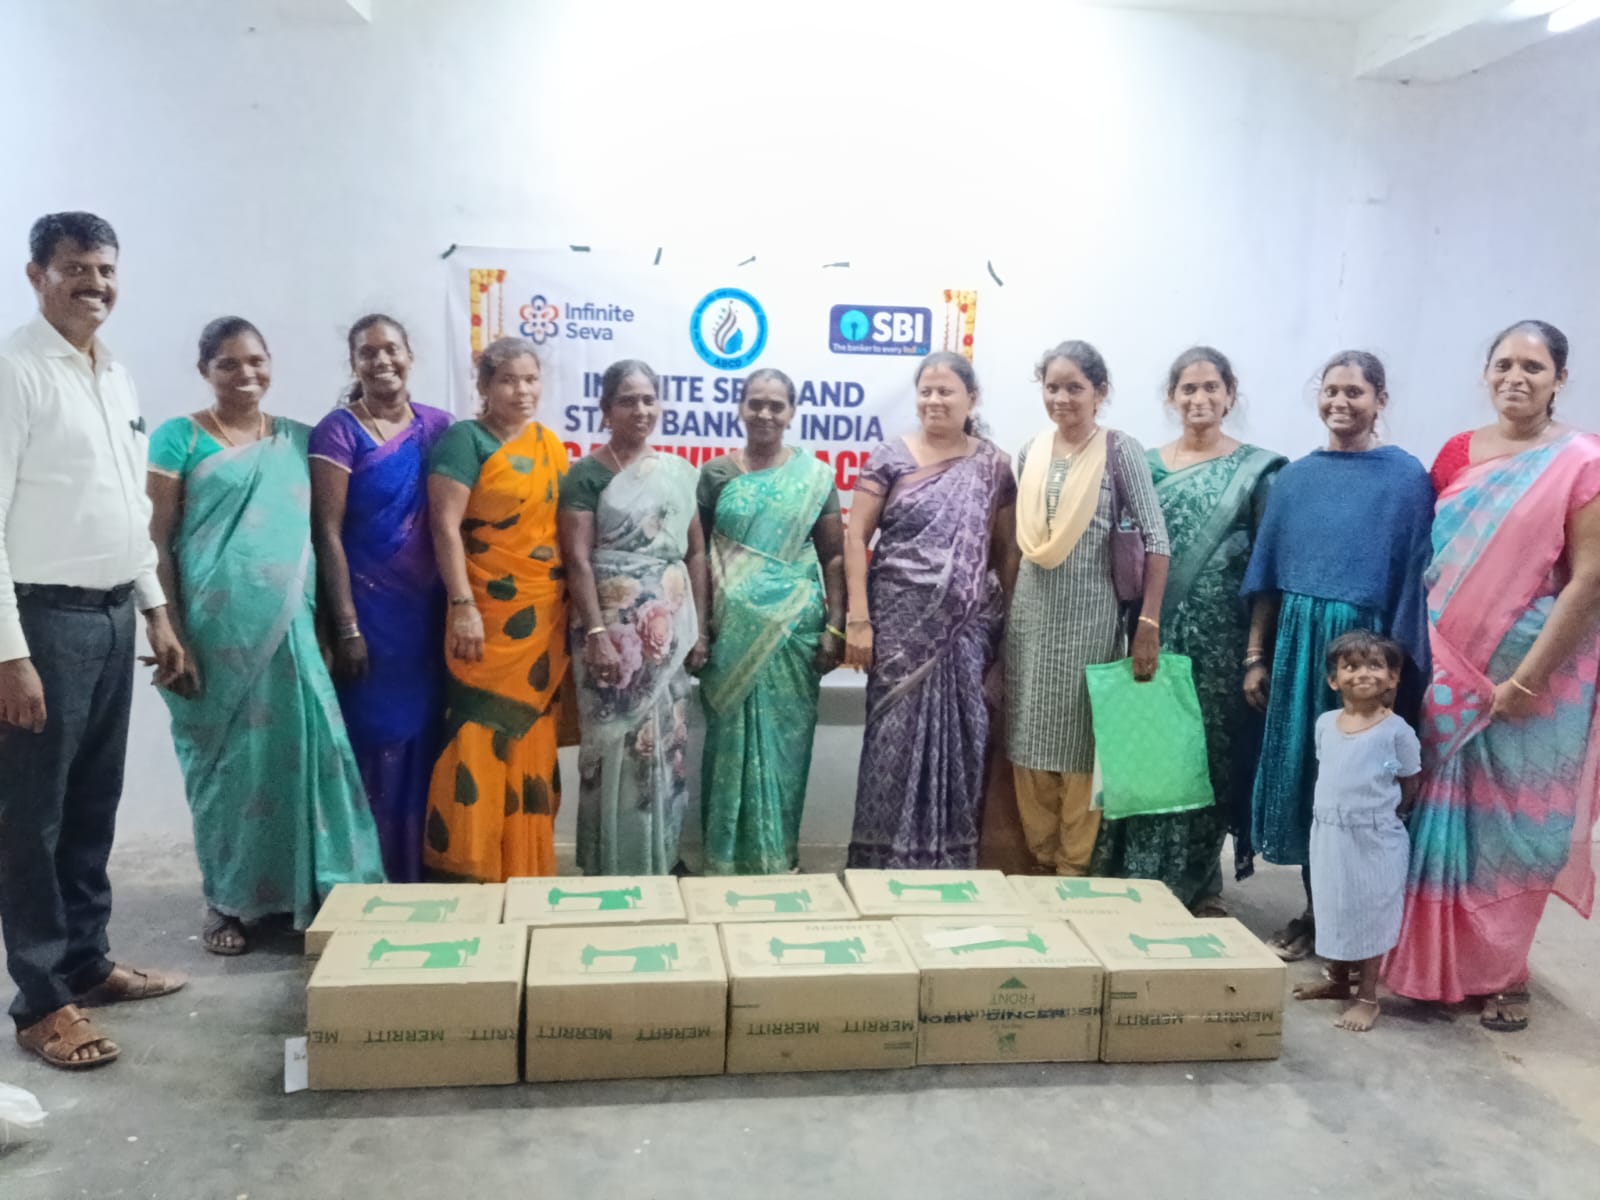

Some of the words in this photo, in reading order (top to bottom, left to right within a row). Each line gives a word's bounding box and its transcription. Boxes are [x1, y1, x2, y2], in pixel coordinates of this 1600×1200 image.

[565, 302, 634, 322] Infinite
[566, 322, 614, 340] Seva
[872, 312, 924, 343] SBI
[798, 380, 865, 408] AND
[662, 409, 744, 438] BANK
[801, 414, 884, 442] INDIA
[536, 1025, 613, 1041] MERRITT
[636, 1025, 711, 1042] MERRITT
[746, 1020, 820, 1036] MERRITT
[843, 1019, 914, 1033] MERRITT
[365, 1028, 445, 1044] MERRITT
